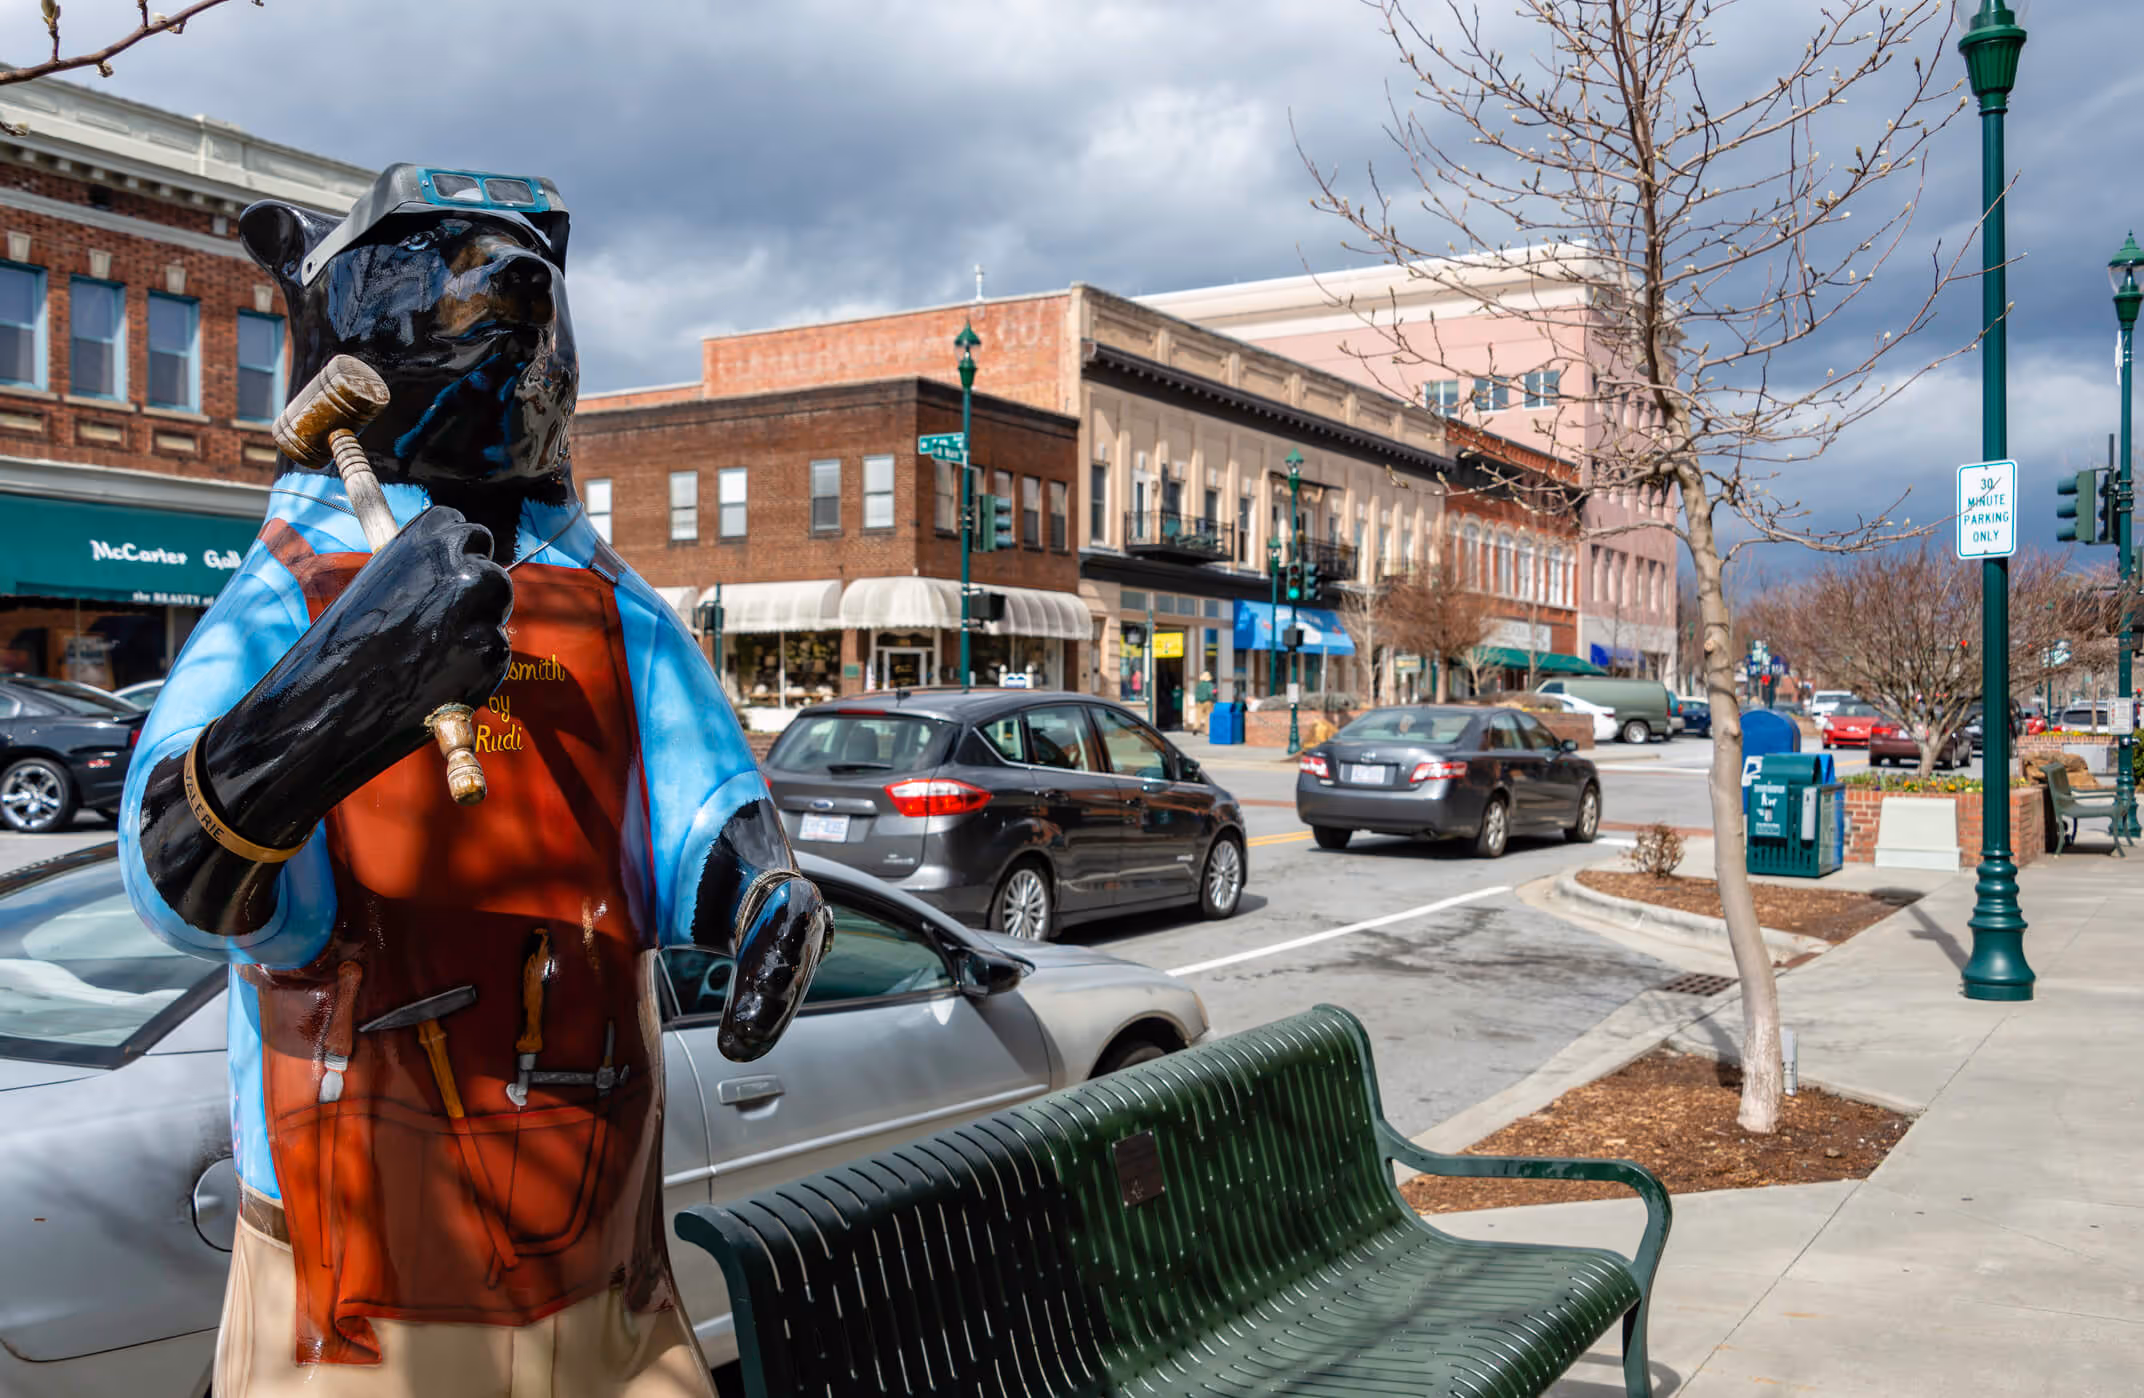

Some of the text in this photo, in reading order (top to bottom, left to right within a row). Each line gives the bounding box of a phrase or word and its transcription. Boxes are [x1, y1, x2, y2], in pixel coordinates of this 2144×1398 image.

[1980, 478, 1994, 490] 30
[1967, 493, 2006, 508] MINUTE
[1963, 511, 2009, 526] PARKING
[1972, 529, 2000, 543] ONLY
[89, 539, 242, 570] McCarter Gall
[504, 653, 566, 682] smith
[475, 723, 526, 754] Rudi
[185, 767, 225, 840] VALERIE
